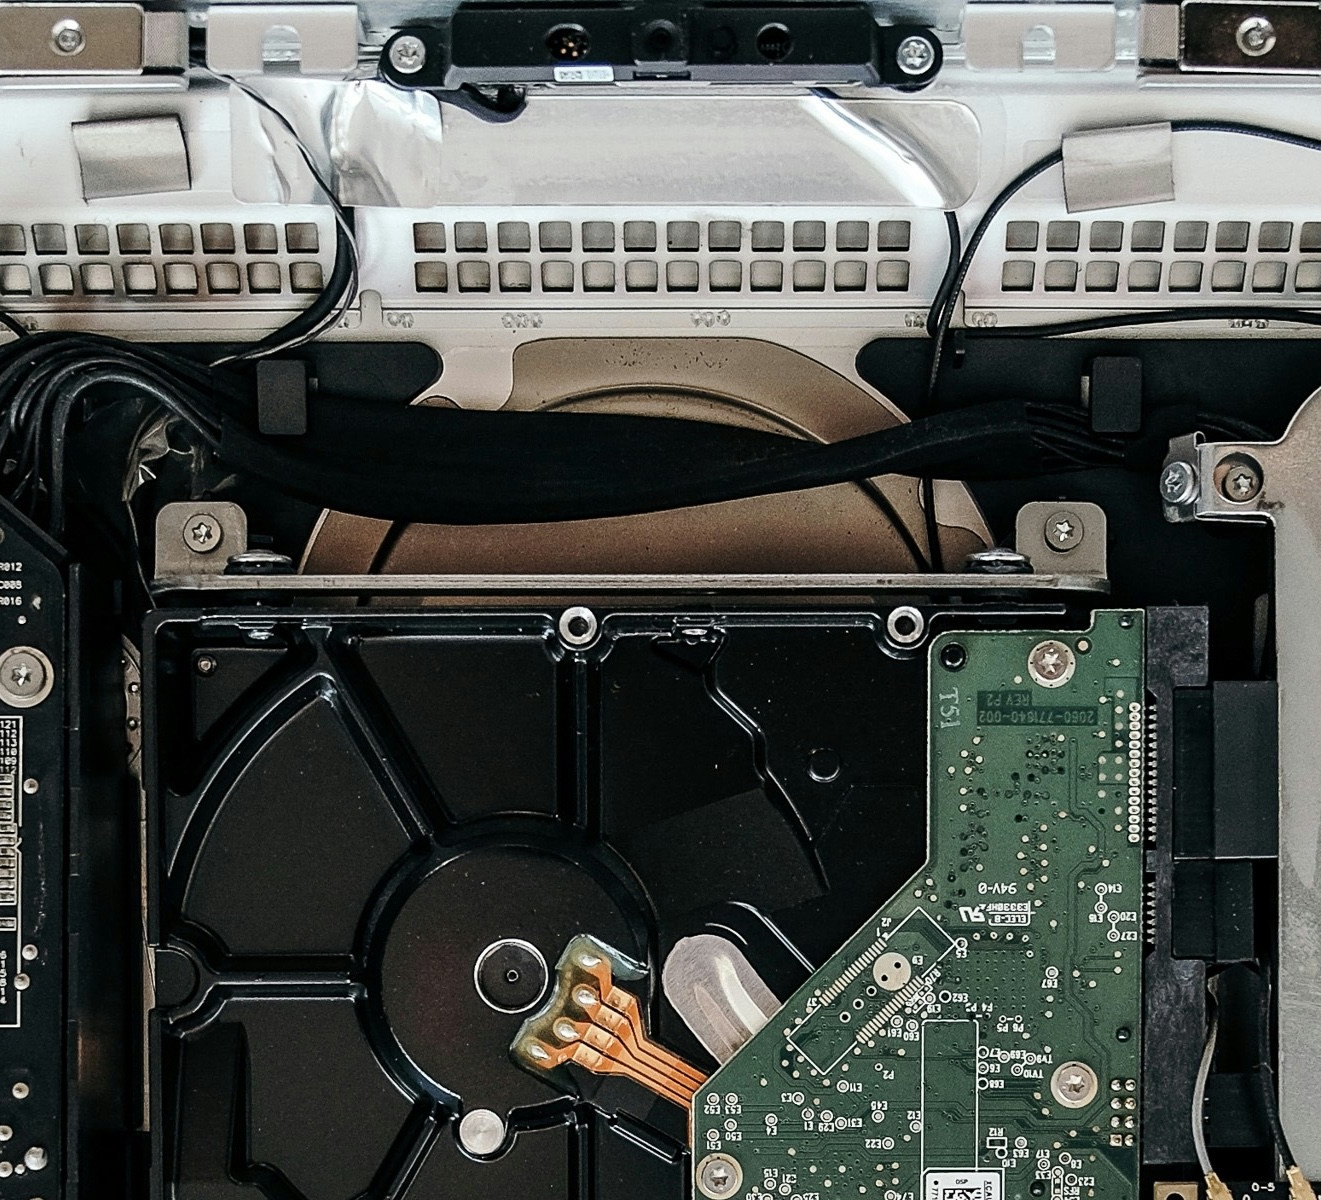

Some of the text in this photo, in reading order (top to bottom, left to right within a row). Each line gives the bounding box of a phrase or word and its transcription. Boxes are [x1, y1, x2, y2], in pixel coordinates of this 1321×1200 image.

[979, 883, 1017, 894] 94V-0
[1120, 931, 1137, 940] E27
[989, 1048, 1000, 1057] E7
[990, 1064, 1000, 1072] E6
[883, 1071, 894, 1079] P2
[849, 1083, 862, 1091] E11
[781, 1093, 792, 1101] E3
[907, 1111, 921, 1119] E12
[706, 1141, 721, 1149] E51
[1071, 1160, 1081, 1168] E8
